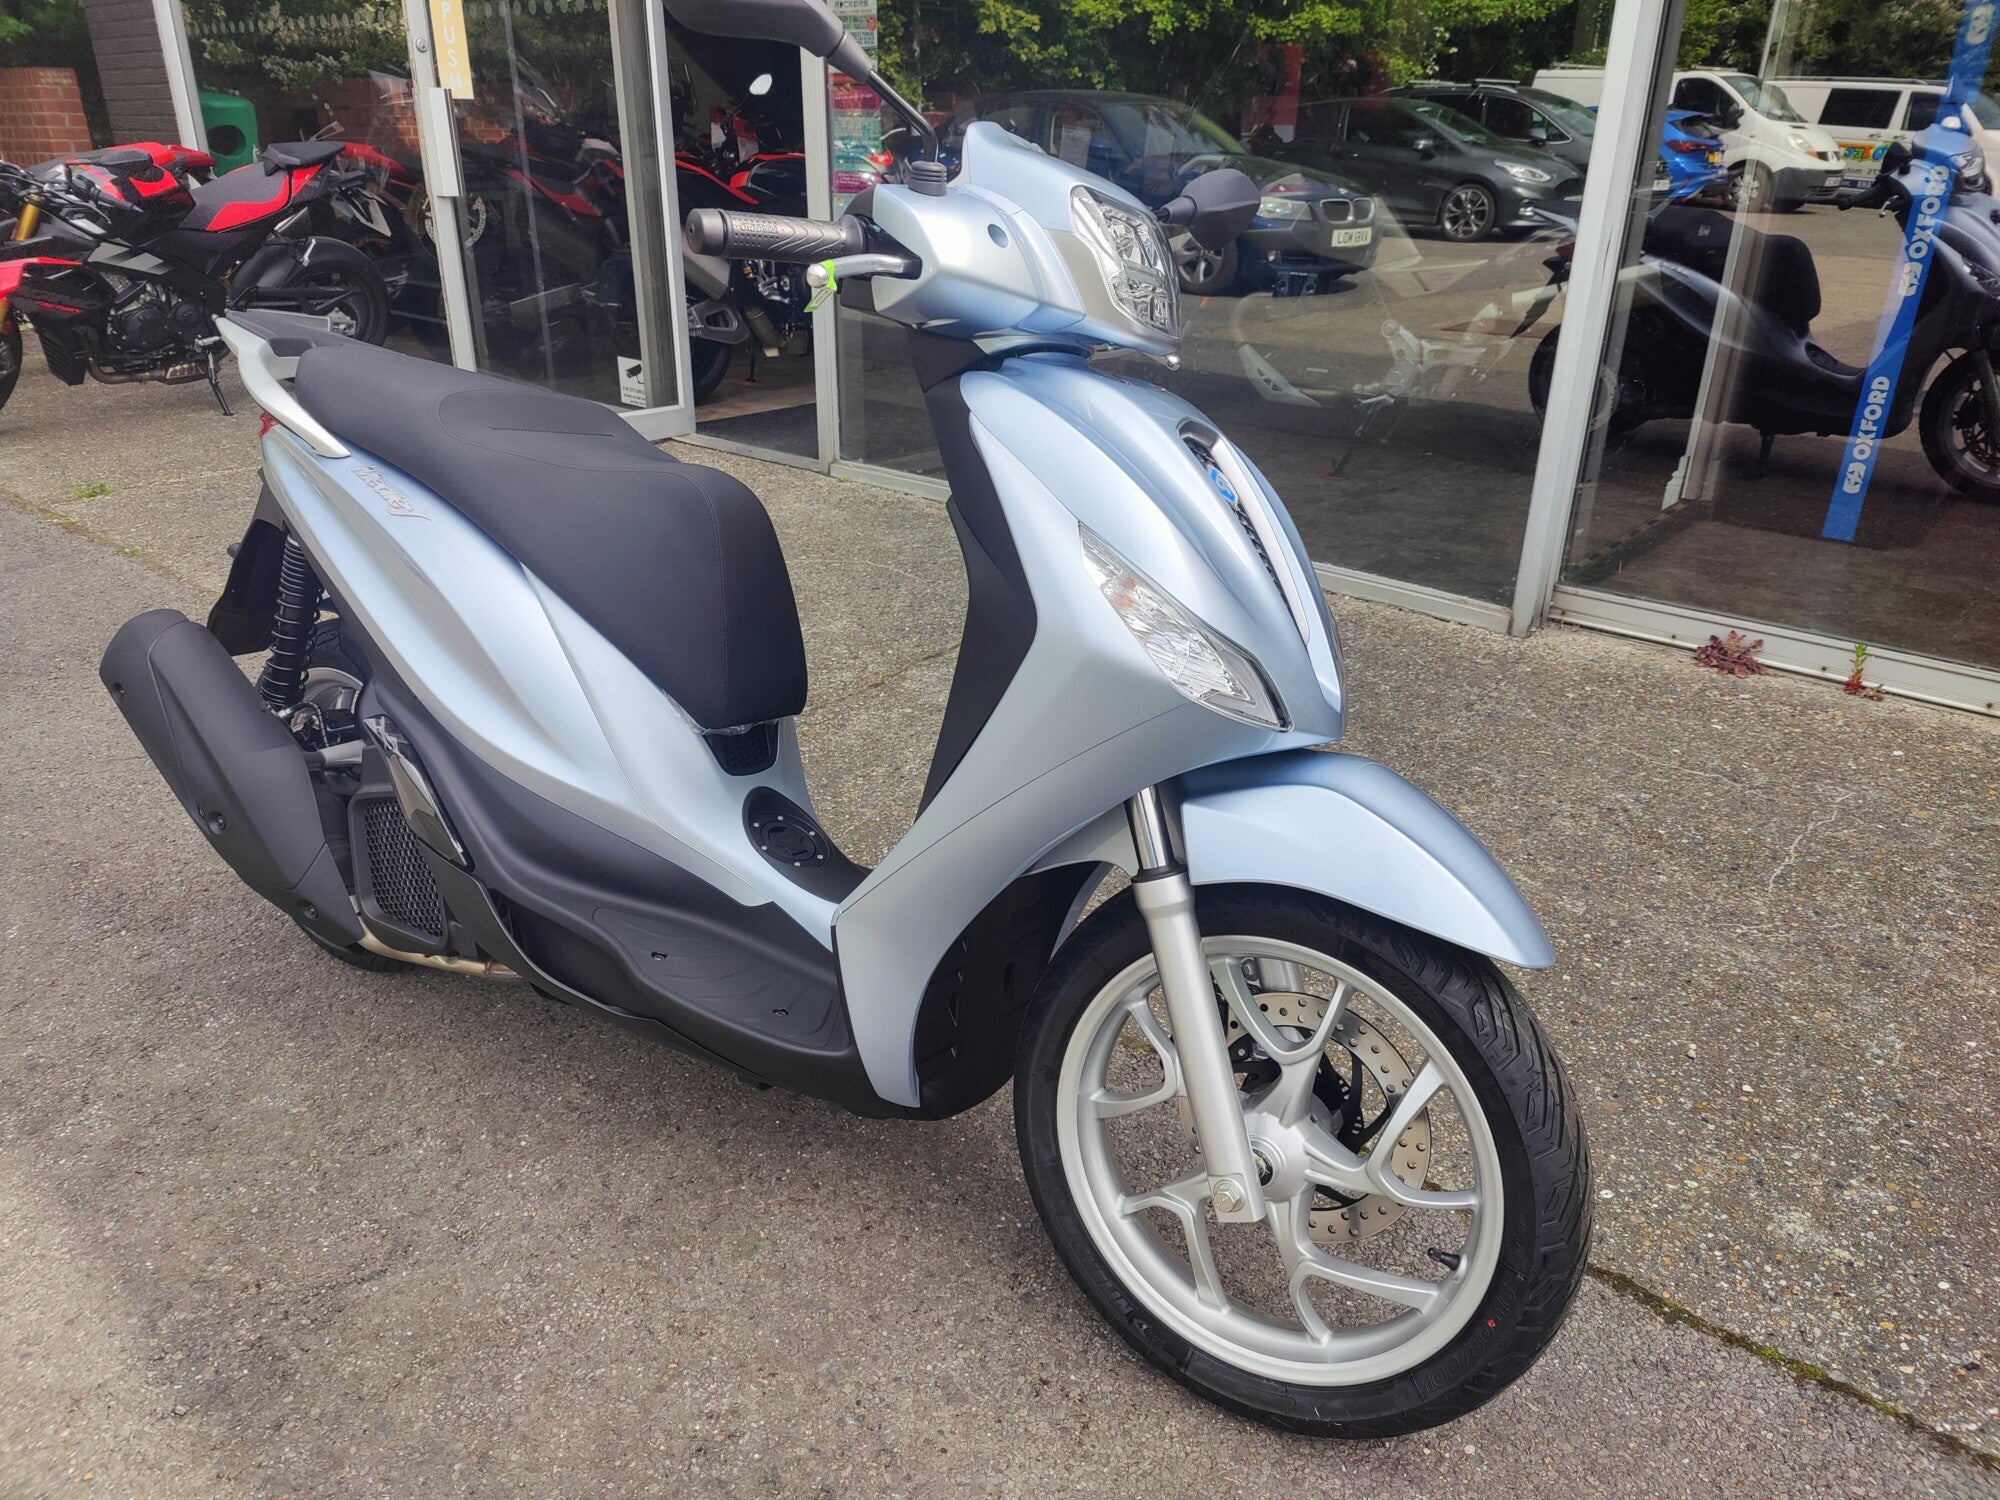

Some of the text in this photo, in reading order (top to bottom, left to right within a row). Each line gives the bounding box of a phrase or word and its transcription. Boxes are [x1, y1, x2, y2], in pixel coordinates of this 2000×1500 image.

[440, 1, 462, 91] PUSH
[1908, 165, 1950, 260] OXFORD
[1852, 376, 1891, 461] OXFORD
